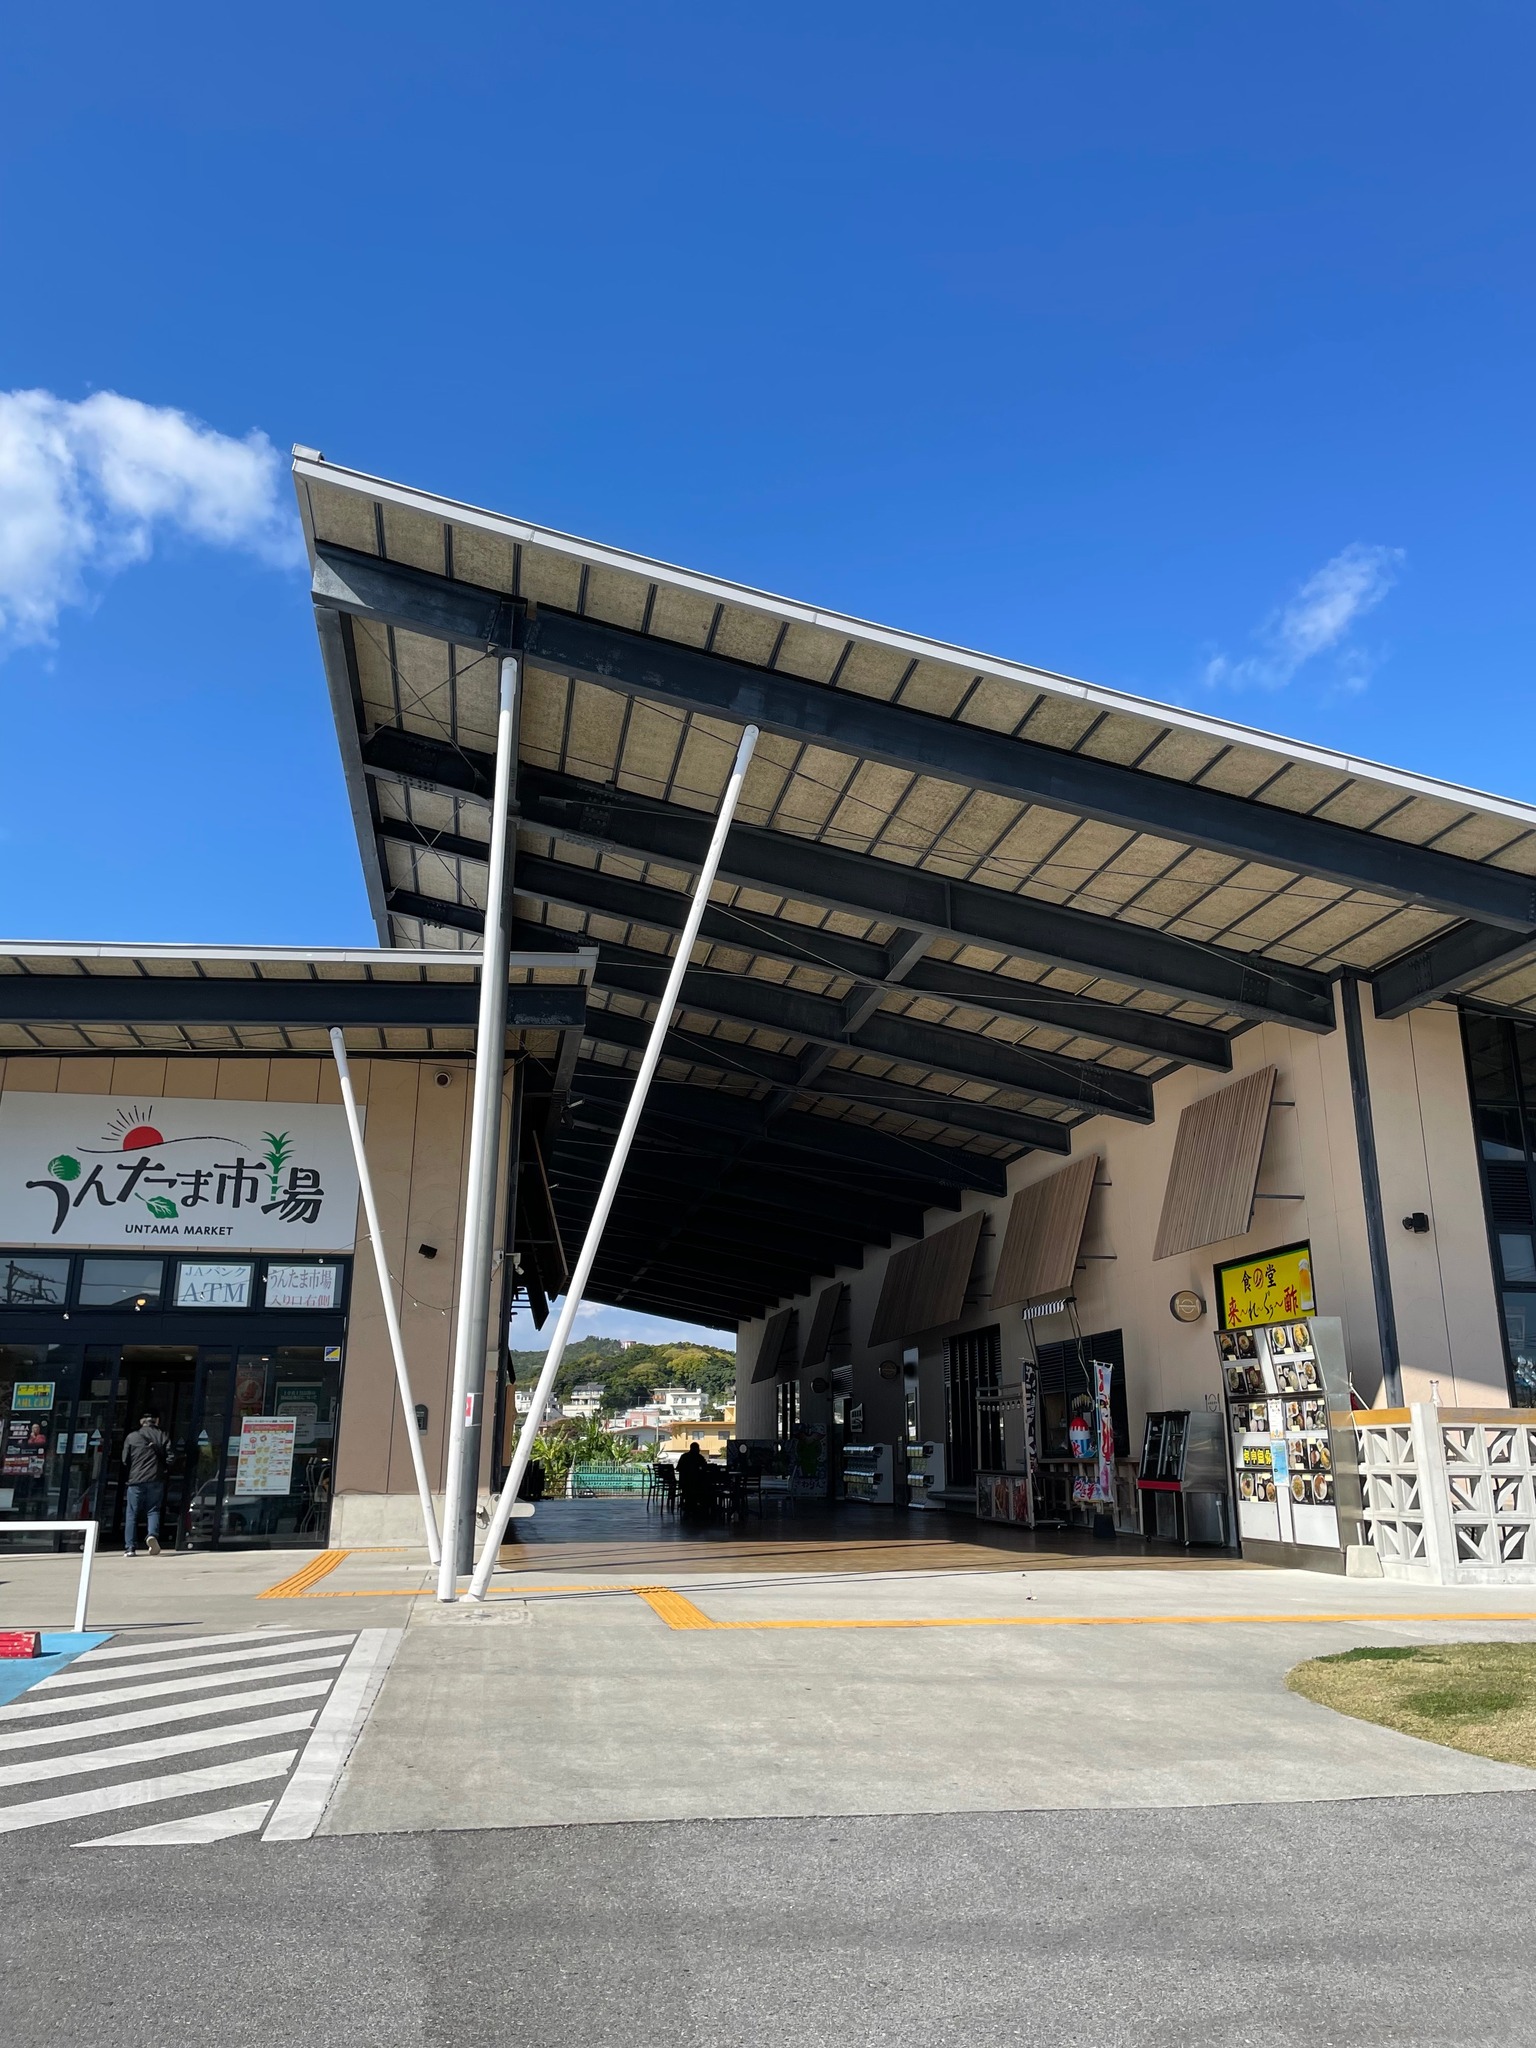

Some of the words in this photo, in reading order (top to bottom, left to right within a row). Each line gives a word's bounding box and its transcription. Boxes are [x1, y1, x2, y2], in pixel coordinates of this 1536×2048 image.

[25, 1152, 325, 1235] うんたま市場
[125, 1224, 179, 1235] UNTAMA
[183, 1225, 234, 1236] MARKET
[185, 1264, 247, 1278] JAバンク
[269, 1268, 333, 1289] うんたま市場
[181, 1282, 246, 1304] ATM
[271, 1295, 331, 1307] 入り口右側
